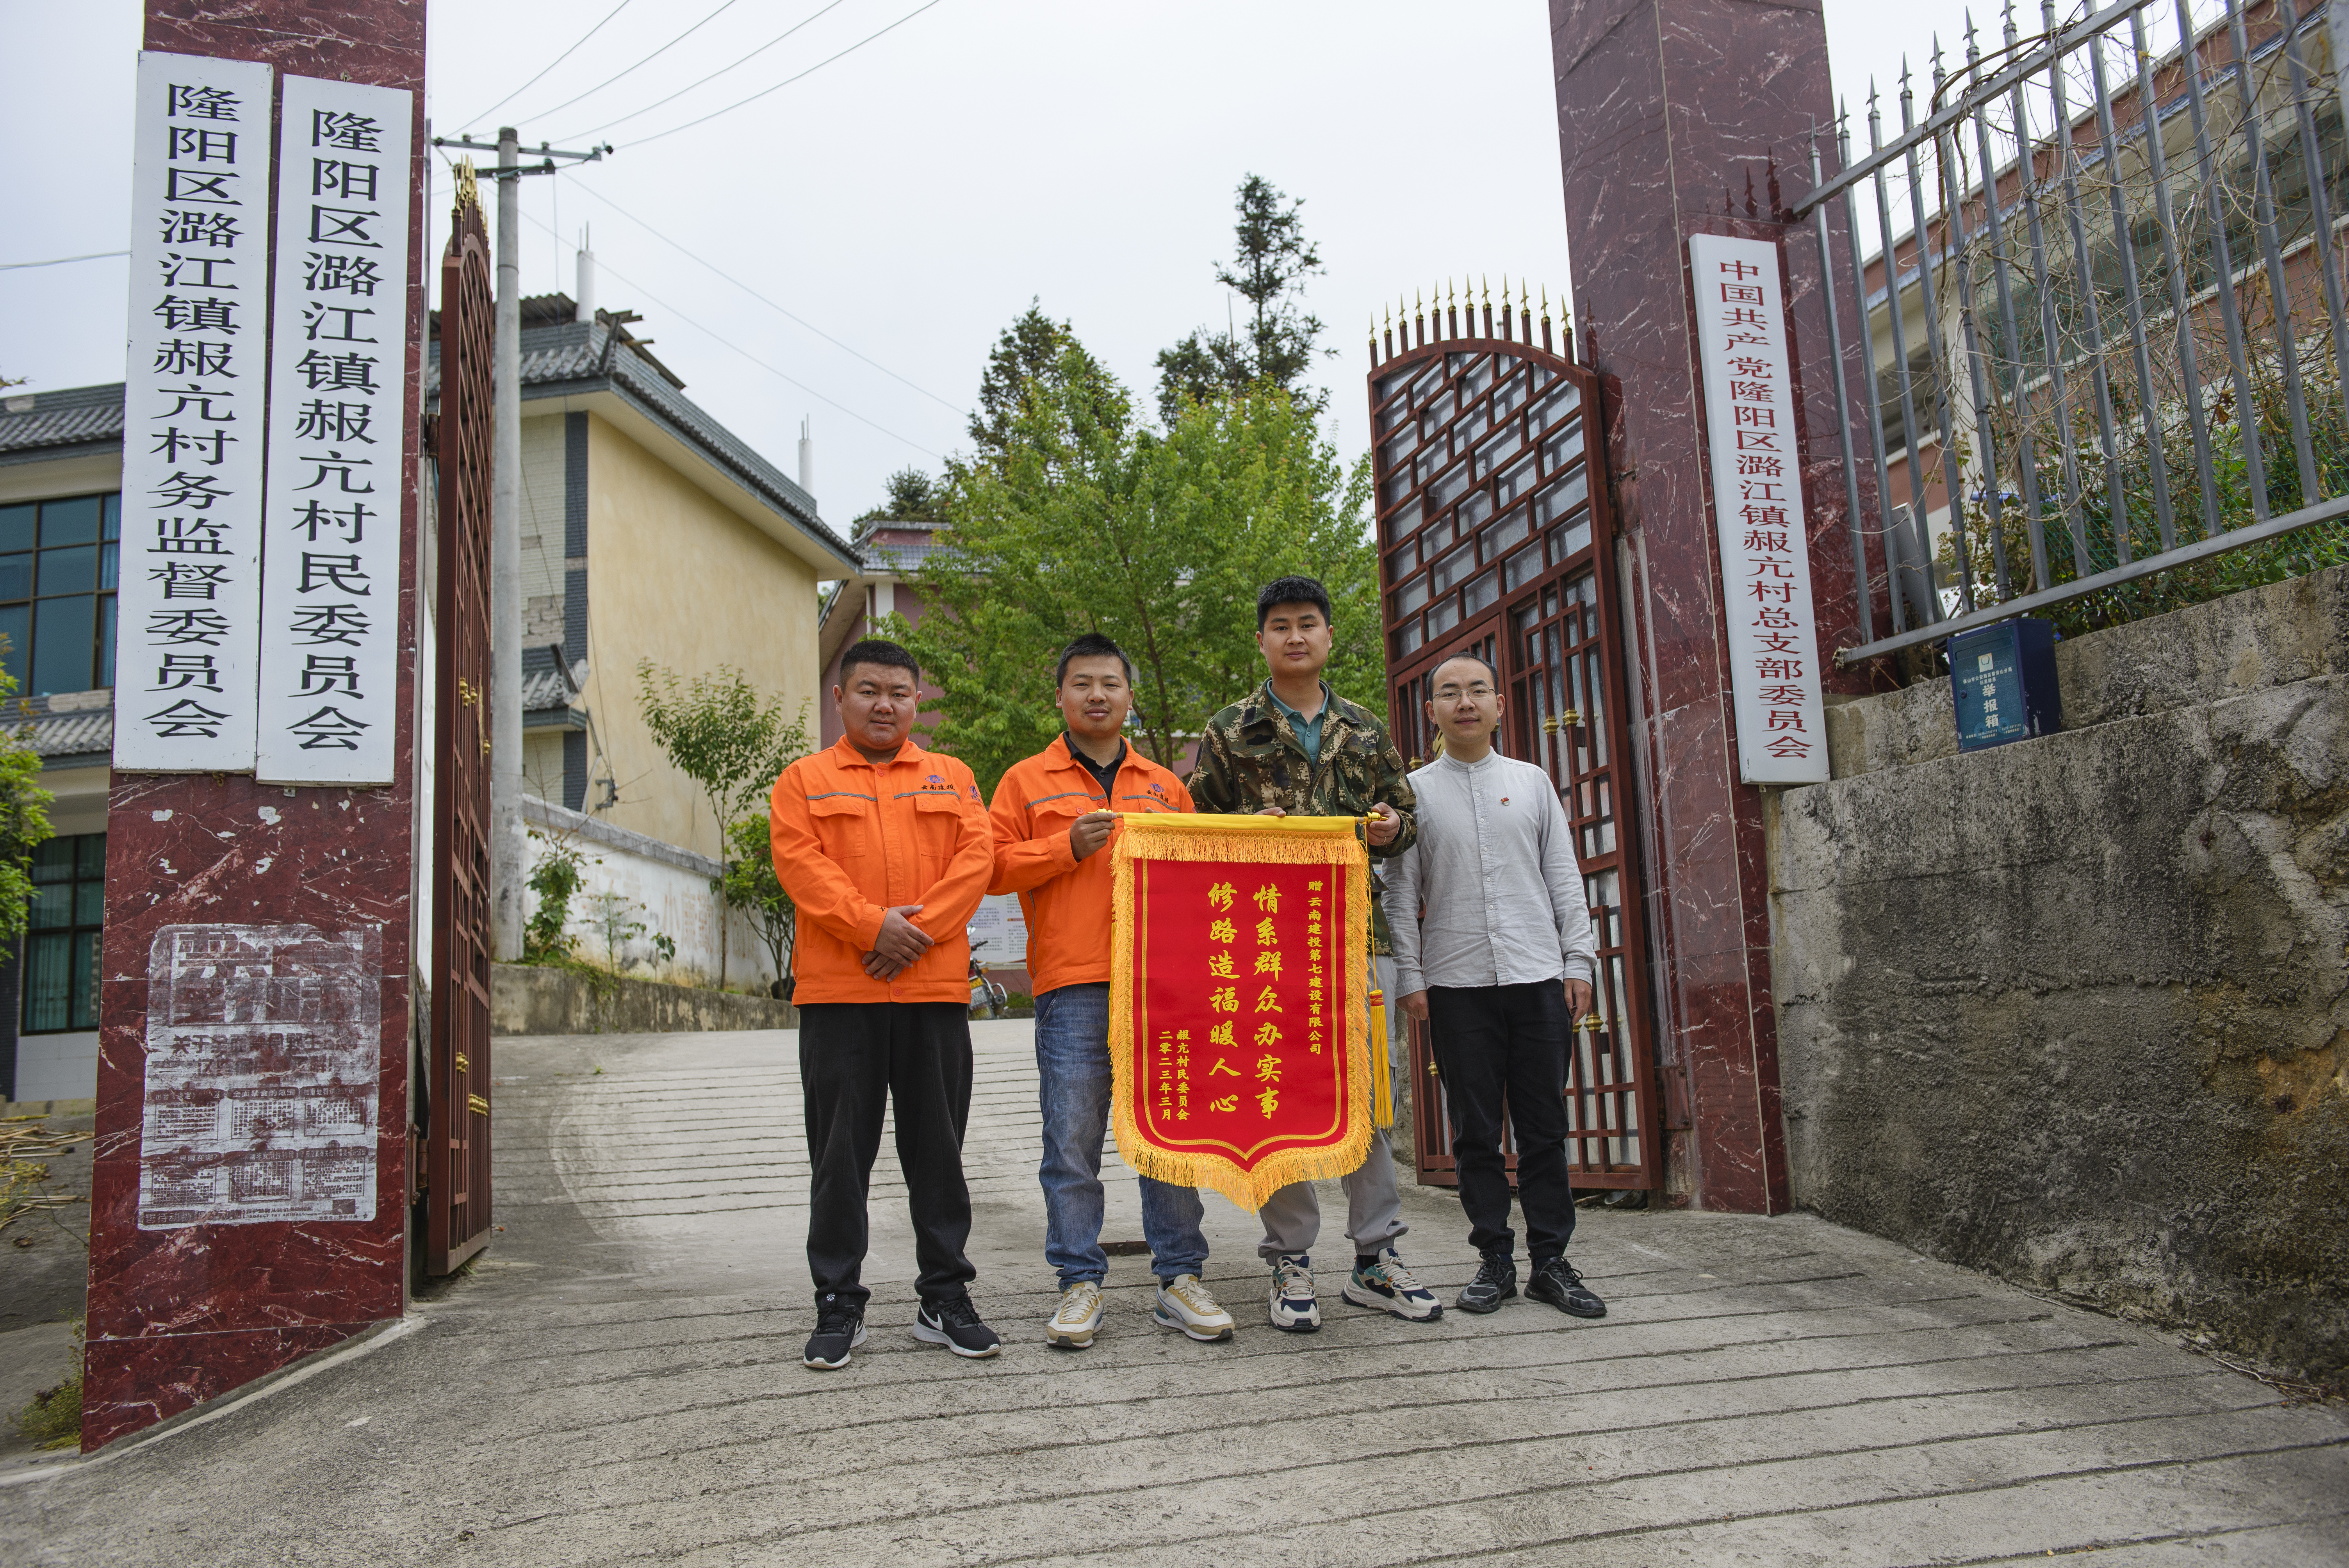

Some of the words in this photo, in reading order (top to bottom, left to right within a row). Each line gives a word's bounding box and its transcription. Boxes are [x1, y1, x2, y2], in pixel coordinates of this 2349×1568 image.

[142, 83, 244, 739] 隆阳区潞江镇赧亢村务监督委员会
[286, 109, 384, 751] 隆阳区潞江镇赧亢村民委员会
[1720, 260, 1813, 759] 中国共产党隆阳区潞江镇赧亢村总支部委员会
[1982, 683, 1999, 728] 举报箱
[233, 1088, 295, 1098] 全面禁食的范围
[1158, 1030, 1173, 1121] 二零二三年三月
[1176, 1029, 1191, 1121] 赧亢村民委员会
[1207, 881, 1242, 1113] 修路造福暖人心
[1253, 883, 1283, 1120] 情系群众办实事
